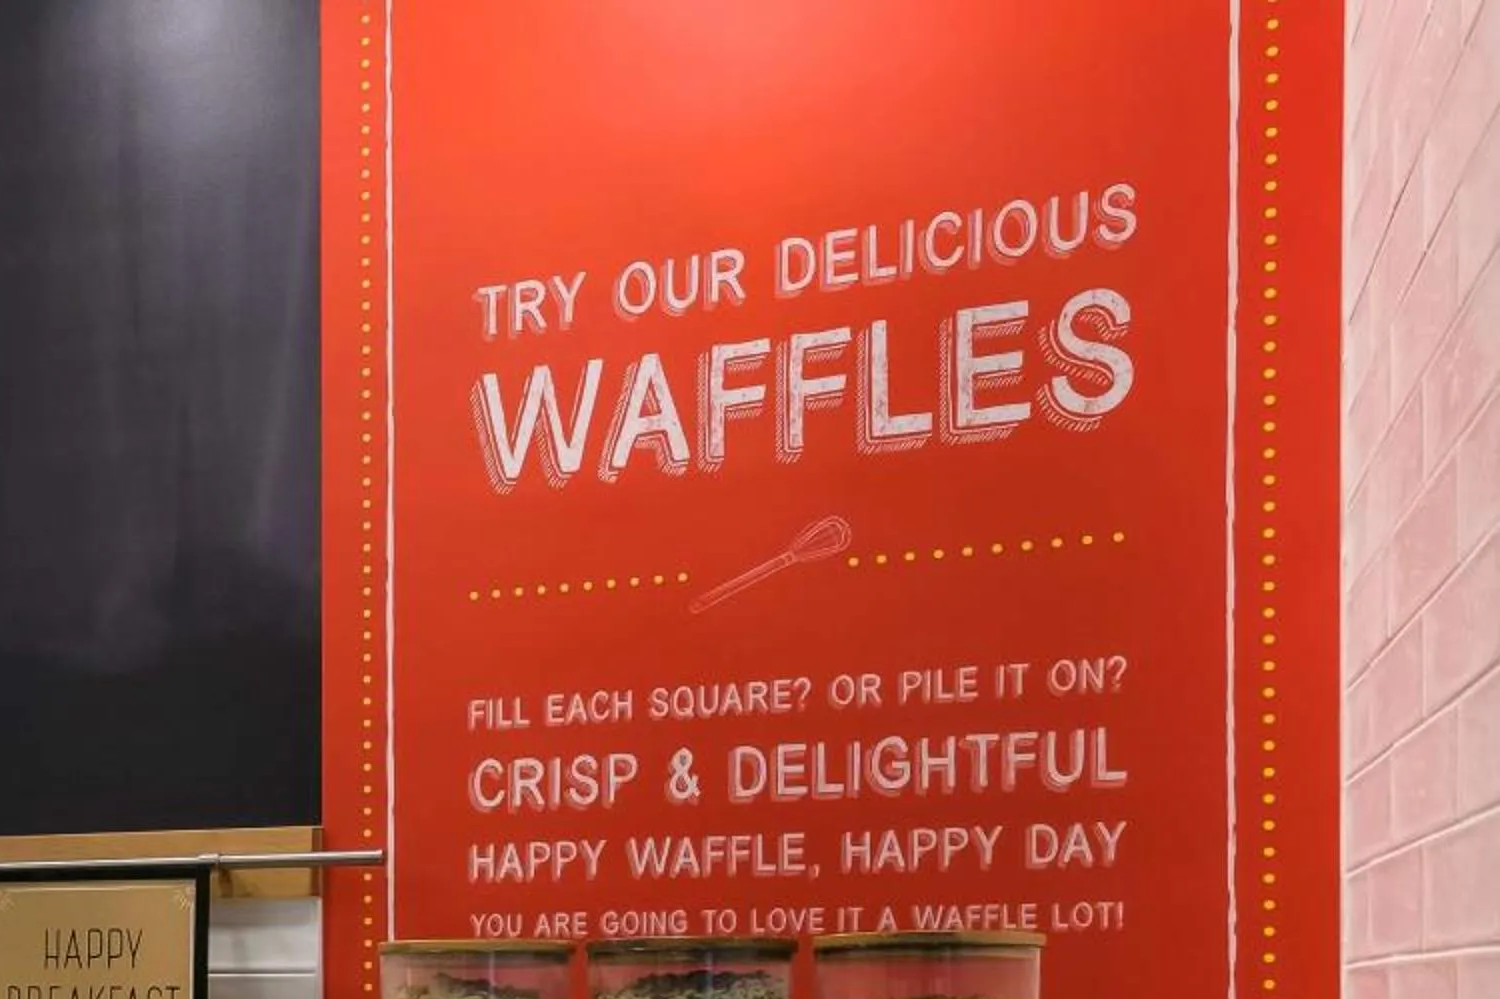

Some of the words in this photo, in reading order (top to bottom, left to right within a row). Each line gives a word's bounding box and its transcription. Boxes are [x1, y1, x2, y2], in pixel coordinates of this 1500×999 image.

[476, 272, 586, 338] TRY
[614, 248, 745, 318] OUR
[775, 184, 1138, 298] DELICIOUS
[470, 287, 1134, 495] WAFFLES
[467, 698, 530, 730] FILL
[545, 690, 633, 726] EACH
[650, 678, 812, 718] SQUARE?
[831, 673, 881, 705] OR
[901, 667, 977, 703] PILE
[995, 663, 1028, 698] IT
[1050, 656, 1128, 692] ON?
[469, 752, 638, 812] CRISP
[667, 747, 701, 800] &
[728, 727, 1128, 800] DELIGHTFUL
[468, 838, 606, 881] HAPPY
[626, 833, 821, 879] WAFFLE,
[841, 826, 1003, 873] HAPPY
[1026, 820, 1128, 868] DAY
[44, 928, 144, 971] HAPPY
[470, 912, 522, 938] YOU
[534, 911, 587, 937] ARE
[601, 909, 688, 936] GOING
[704, 908, 738, 934] TO
[750, 906, 825, 933] LOVE
[836, 906, 863, 932] IT
[876, 904, 898, 931] A
[912, 902, 1038, 931] WAFFLE
[1052, 901, 1125, 931] LOT!
